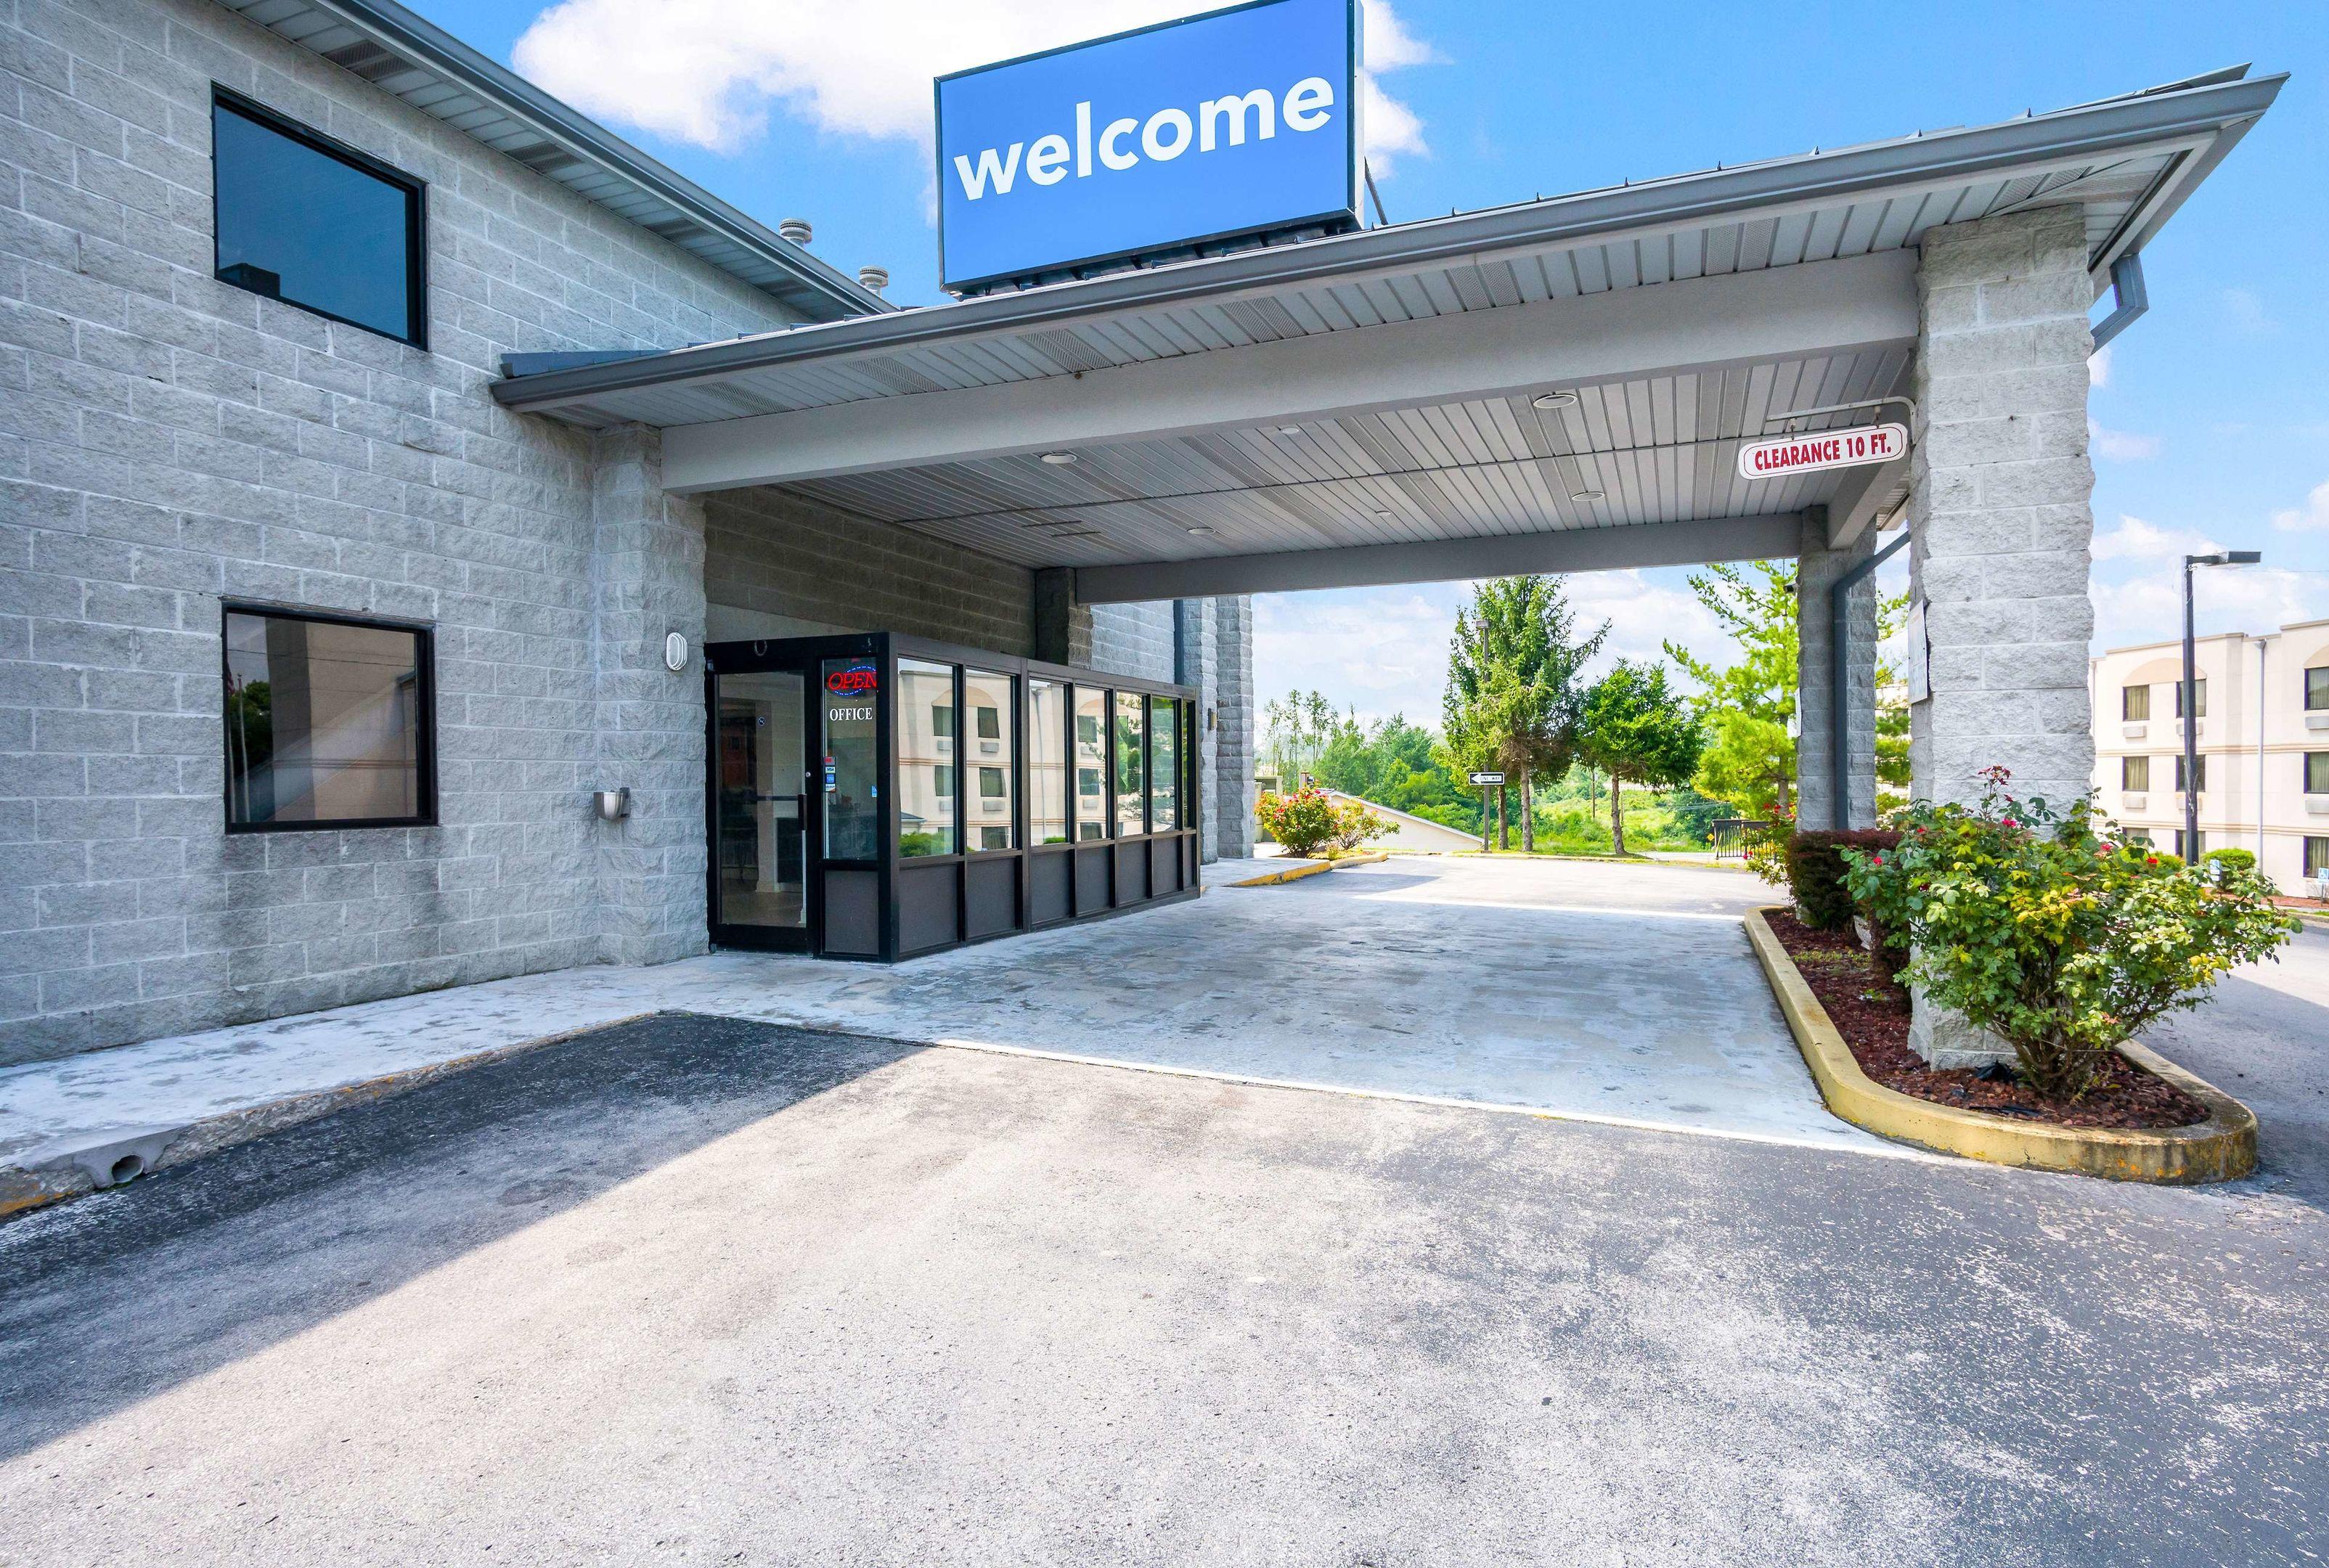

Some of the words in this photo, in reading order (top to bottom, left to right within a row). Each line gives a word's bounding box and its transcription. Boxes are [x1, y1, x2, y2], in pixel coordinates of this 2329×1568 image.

[953, 77, 1334, 200] welcome
[1755, 439, 1840, 471] CLEARANCE
[1846, 436, 1865, 457] 10
[1870, 433, 1891, 454] FT.
[828, 671, 877, 690] OPEN
[829, 707, 873, 721] OFFICE
